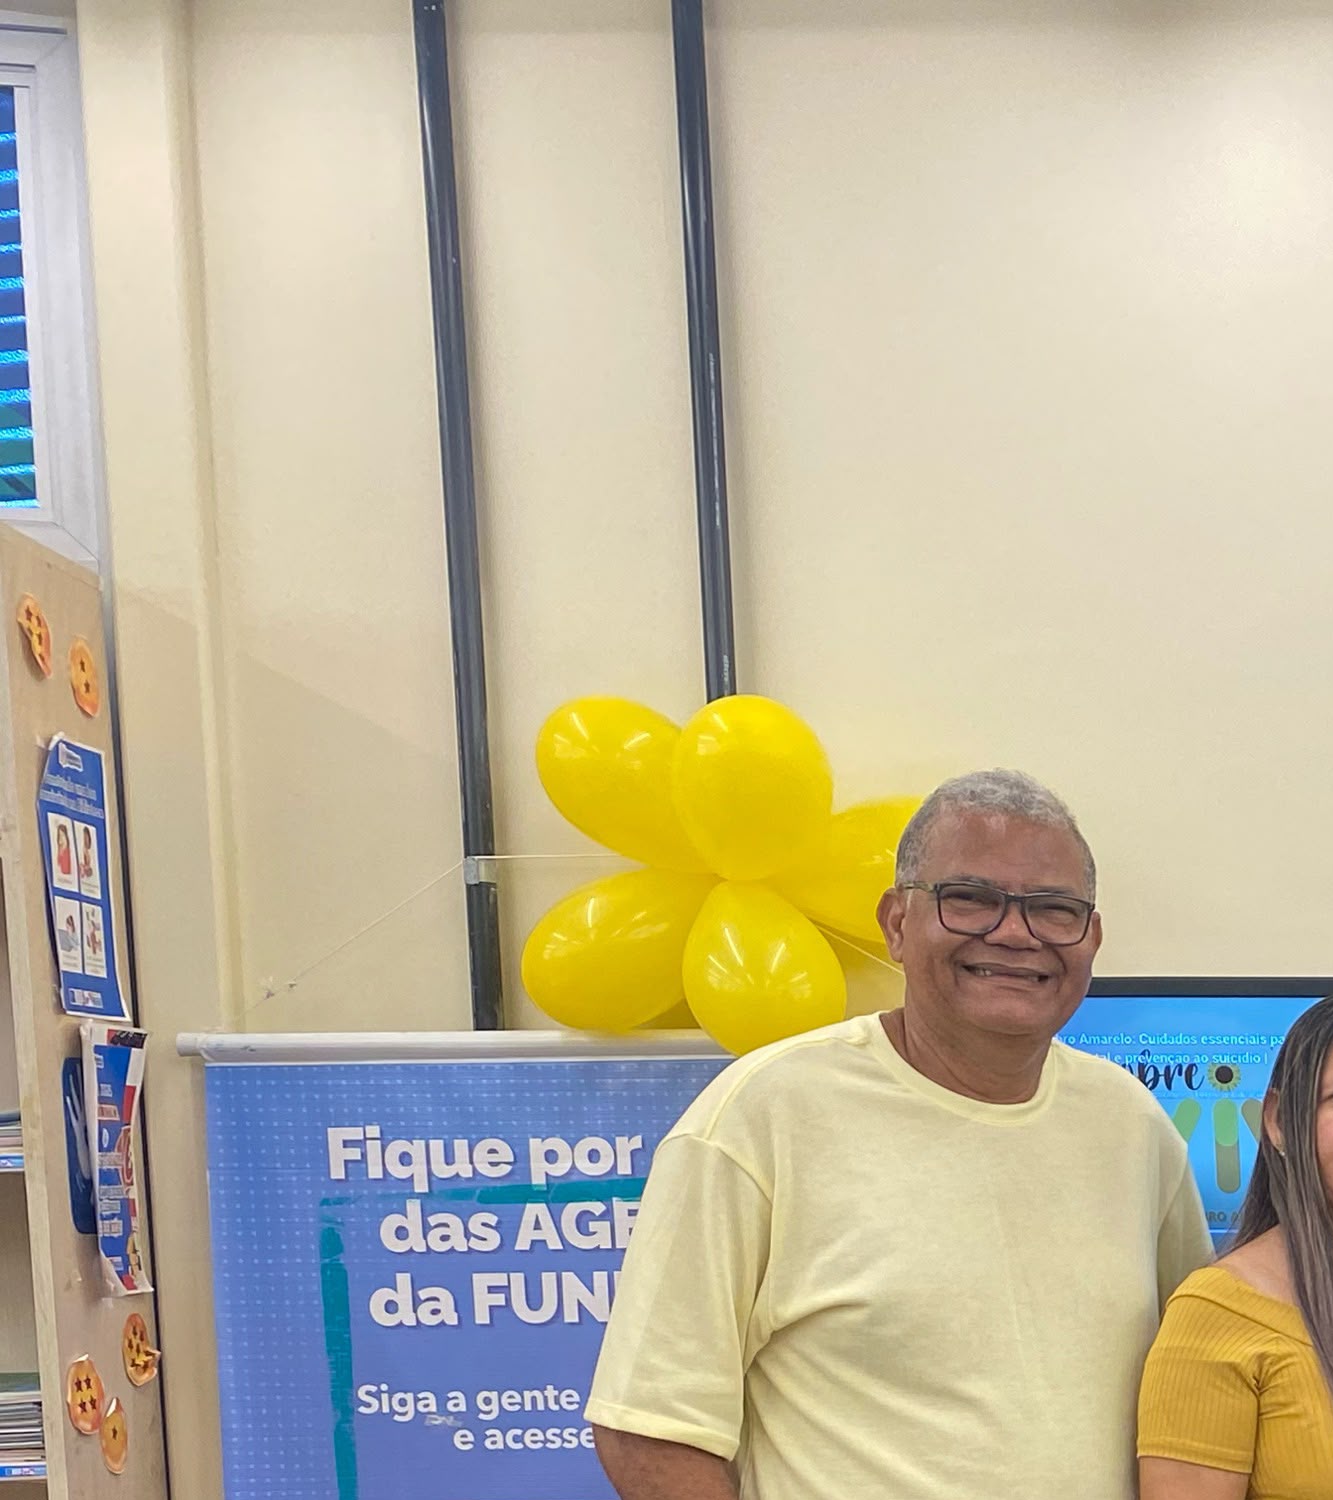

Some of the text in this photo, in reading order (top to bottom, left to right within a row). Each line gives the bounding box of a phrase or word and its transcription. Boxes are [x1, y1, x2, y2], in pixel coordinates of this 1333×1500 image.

[1079, 1033, 1136, 1045] Amarelo:
[1139, 1033, 1198, 1045] Cuidados
[1201, 1033, 1266, 1045] essenciais
[1195, 1055, 1208, 1063] ao
[327, 1125, 643, 1193] Fique por
[379, 1198, 501, 1254] das
[369, 1271, 621, 1327] da FUN
[357, 1384, 580, 1422] Siga a gente
[453, 1427, 595, 1450] e acesse
